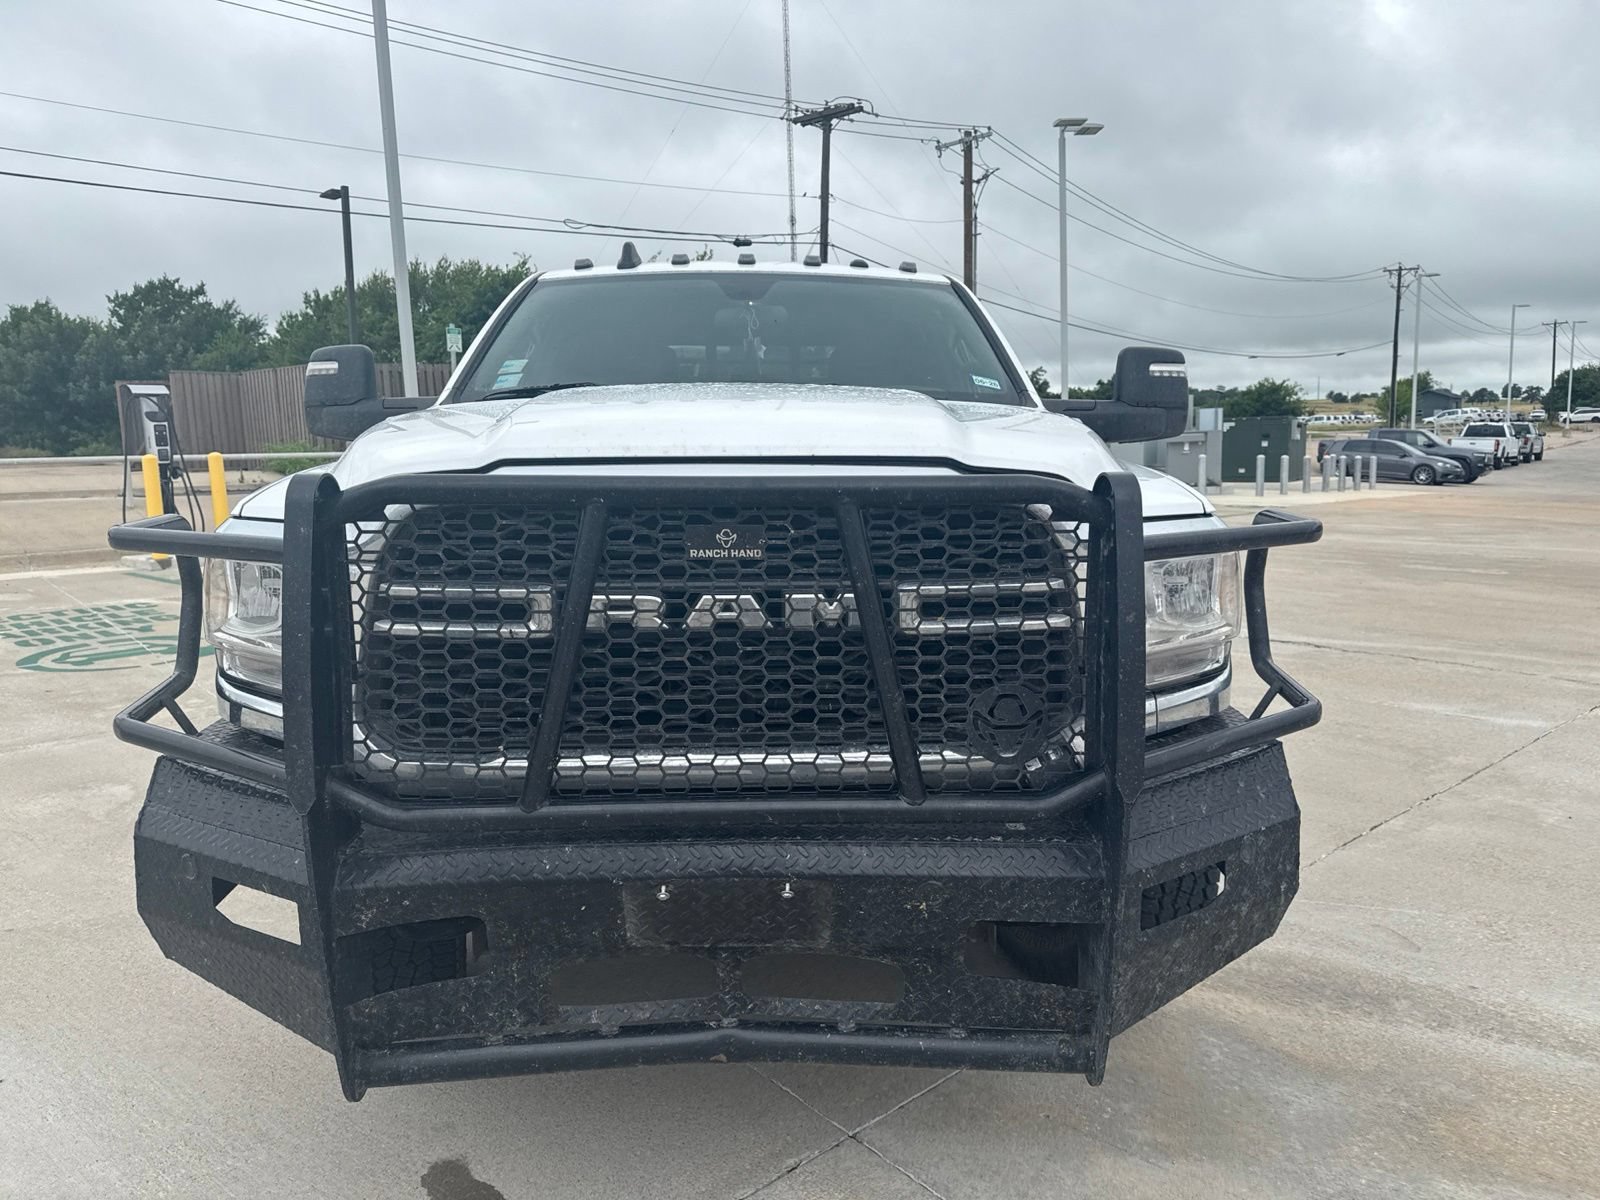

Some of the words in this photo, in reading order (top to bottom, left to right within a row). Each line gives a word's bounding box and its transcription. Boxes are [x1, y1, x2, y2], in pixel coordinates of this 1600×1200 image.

[689, 549, 728, 558] RANCH
[731, 549, 762, 558] HAND
[0, 602, 158, 623] CTRIC
[585, 593, 862, 630] RAM
[14, 624, 155, 647] ONLY
